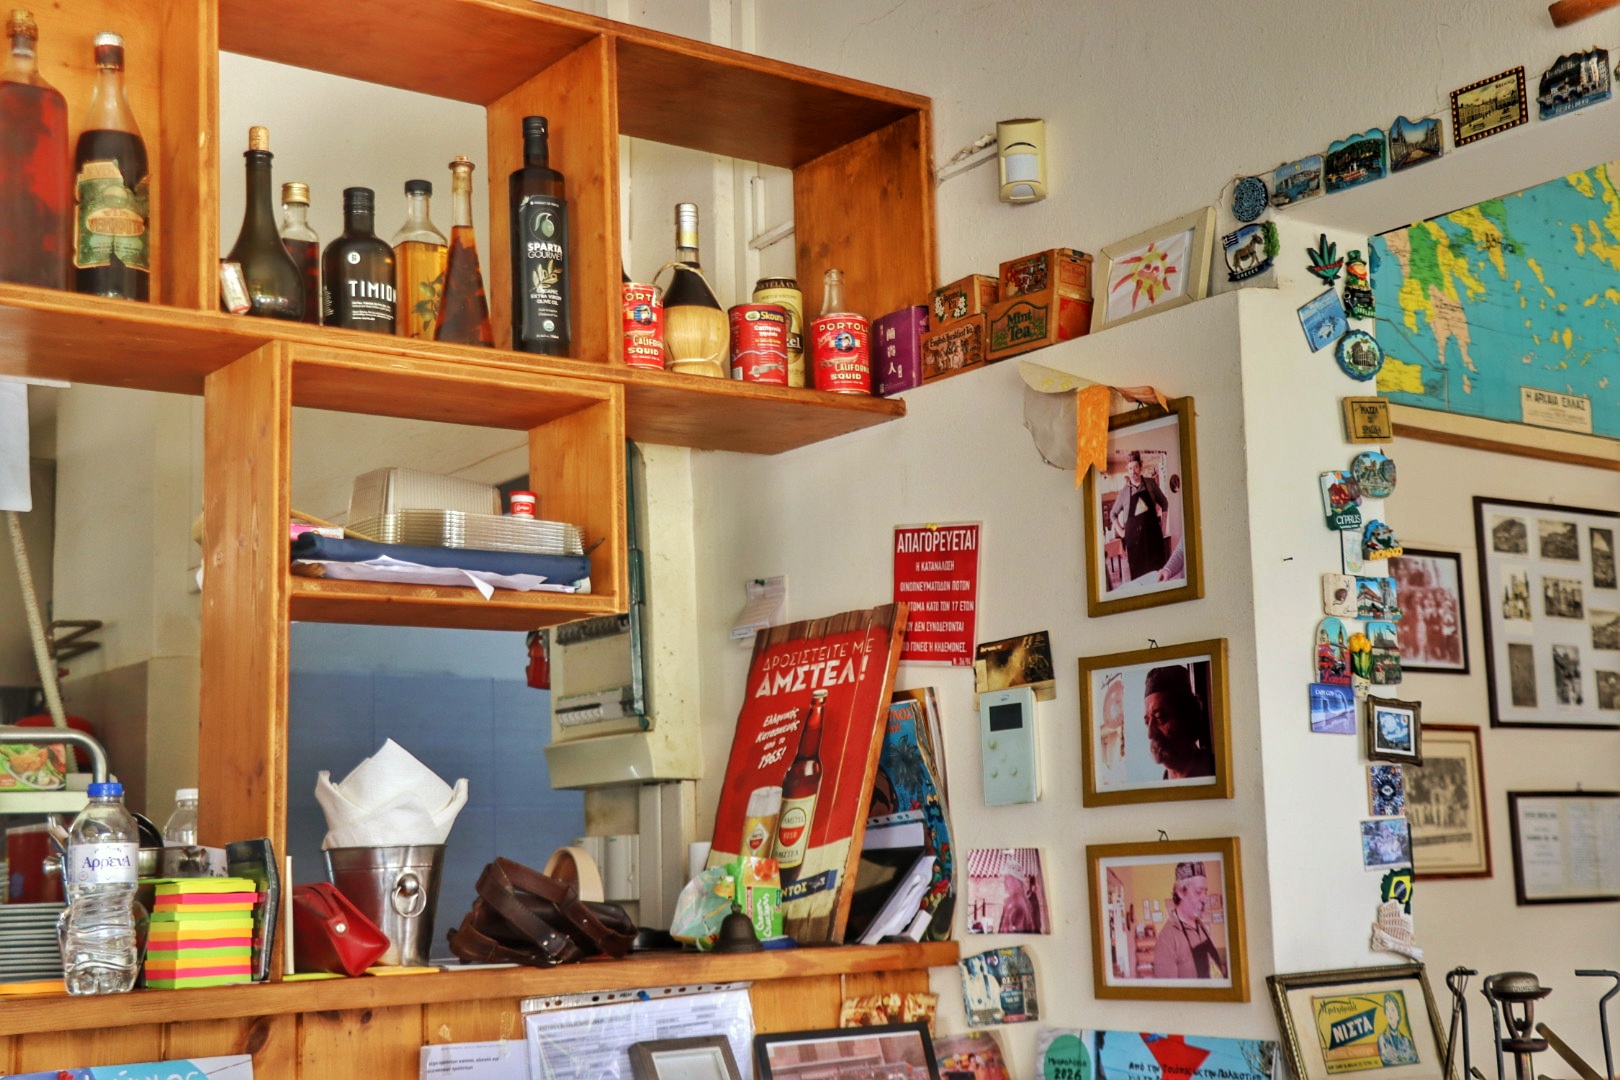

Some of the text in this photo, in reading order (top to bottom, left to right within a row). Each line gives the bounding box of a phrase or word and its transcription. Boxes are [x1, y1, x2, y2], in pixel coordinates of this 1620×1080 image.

[527, 242, 562, 255] SPARTA
[527, 250, 563, 262] GOURMET
[1007, 309, 1033, 327] Mint
[1009, 326, 1032, 343] Tea
[627, 347, 659, 356] SQUID
[830, 373, 862, 381] SQUID
[1335, 514, 1361, 525] CYPRUS
[897, 529, 976, 553] ΑΠΑΓΟΡΕΥΕΤΑΙ
[1369, 546, 1403, 561] MONACO
[921, 561, 955, 571] ΚΑΤΑΝΑΛΩΣΗ
[900, 580, 971, 592] ΟΙΝΟΠΝΕΥΜΑΤΩΔΩΝ ΠΟΤΩΝ
[926, 602, 940, 611] ΚΑΤΩ
[940, 602, 951, 611] ΤΩΝ
[952, 602, 959, 611] 17
[960, 601, 975, 611] ΕΤΩΝ
[914, 622, 925, 632] ΔΕΝ
[926, 621, 965, 632] ΣΥΝΟΔΕΥΟΝΤΑΙ
[910, 642, 928, 652] ΓΟΝΕΙΣ
[762, 638, 875, 672] ΔΡΟΣΙΣΤΕΙΤΕ ΜΕ
[1321, 671, 1350, 685] London
[762, 707, 800, 728] Ελληνικής
[755, 719, 800, 744] Κατασκευής
[757, 746, 787, 770] 1965!
[781, 881, 808, 899] ΝΤΟΣ
[755, 897, 764, 932] Cream
[762, 892, 774, 938] Crackers
[1332, 1015, 1374, 1044] ΝΙΣΤΑ
[1054, 1068, 1081, 1080] 2026
[1128, 1061, 1145, 1072] Από
[1147, 1063, 1160, 1073] την
